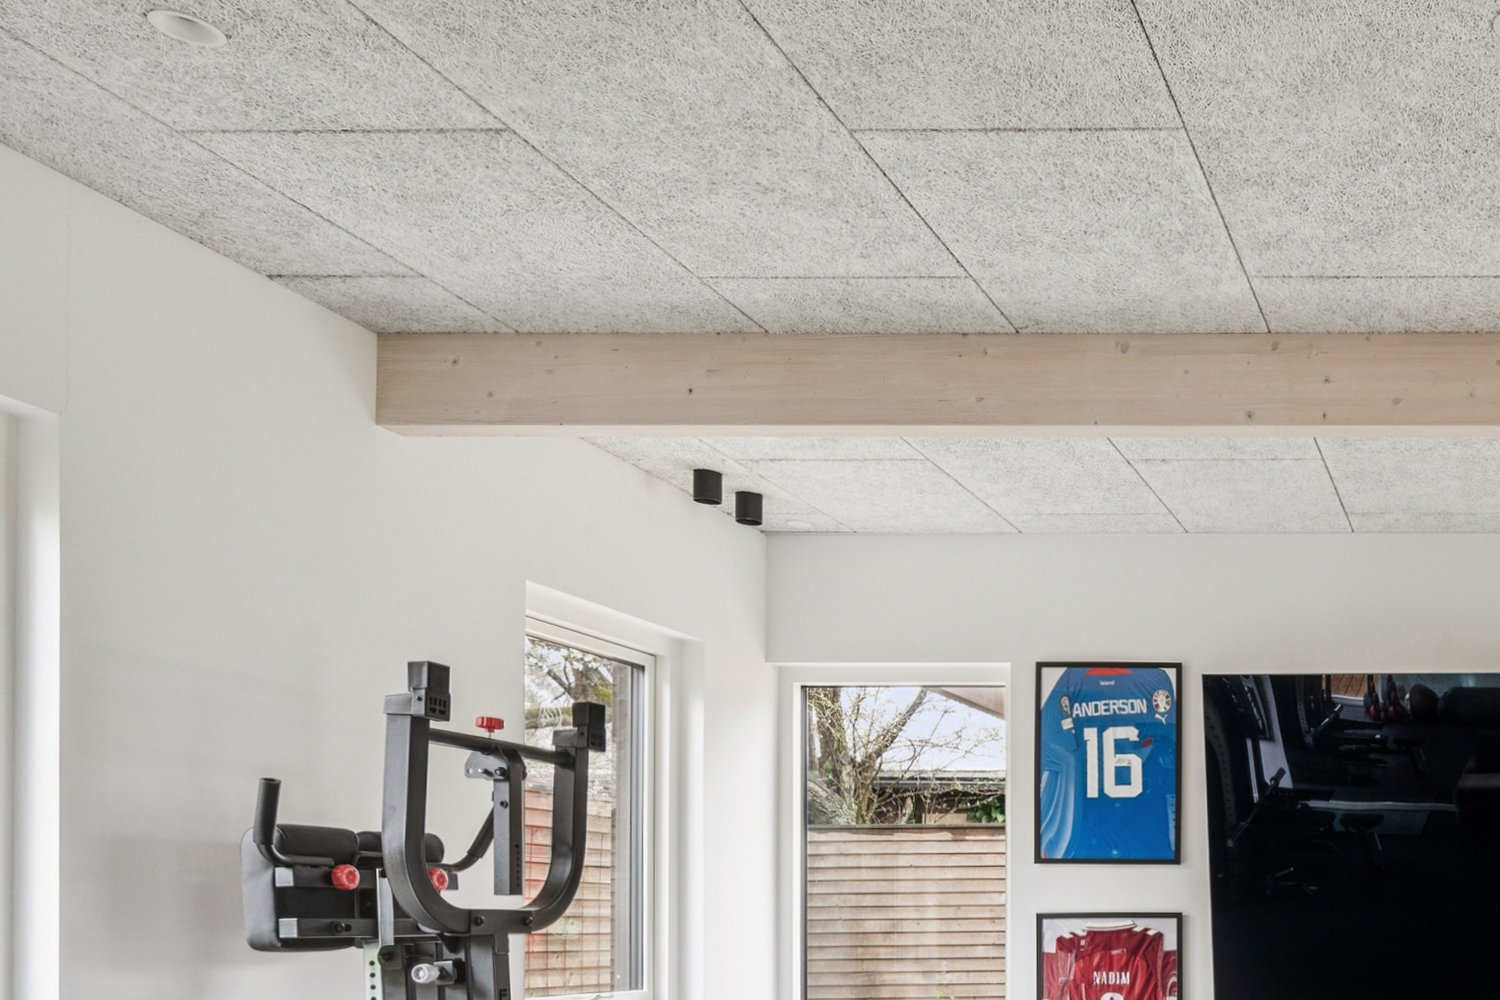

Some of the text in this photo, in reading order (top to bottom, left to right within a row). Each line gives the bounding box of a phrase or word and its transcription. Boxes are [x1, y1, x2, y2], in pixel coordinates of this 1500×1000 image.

[1072, 699, 1148, 718] ANDERSON
[1083, 726, 1144, 798] 16
[1093, 970, 1131, 985] NADIM
